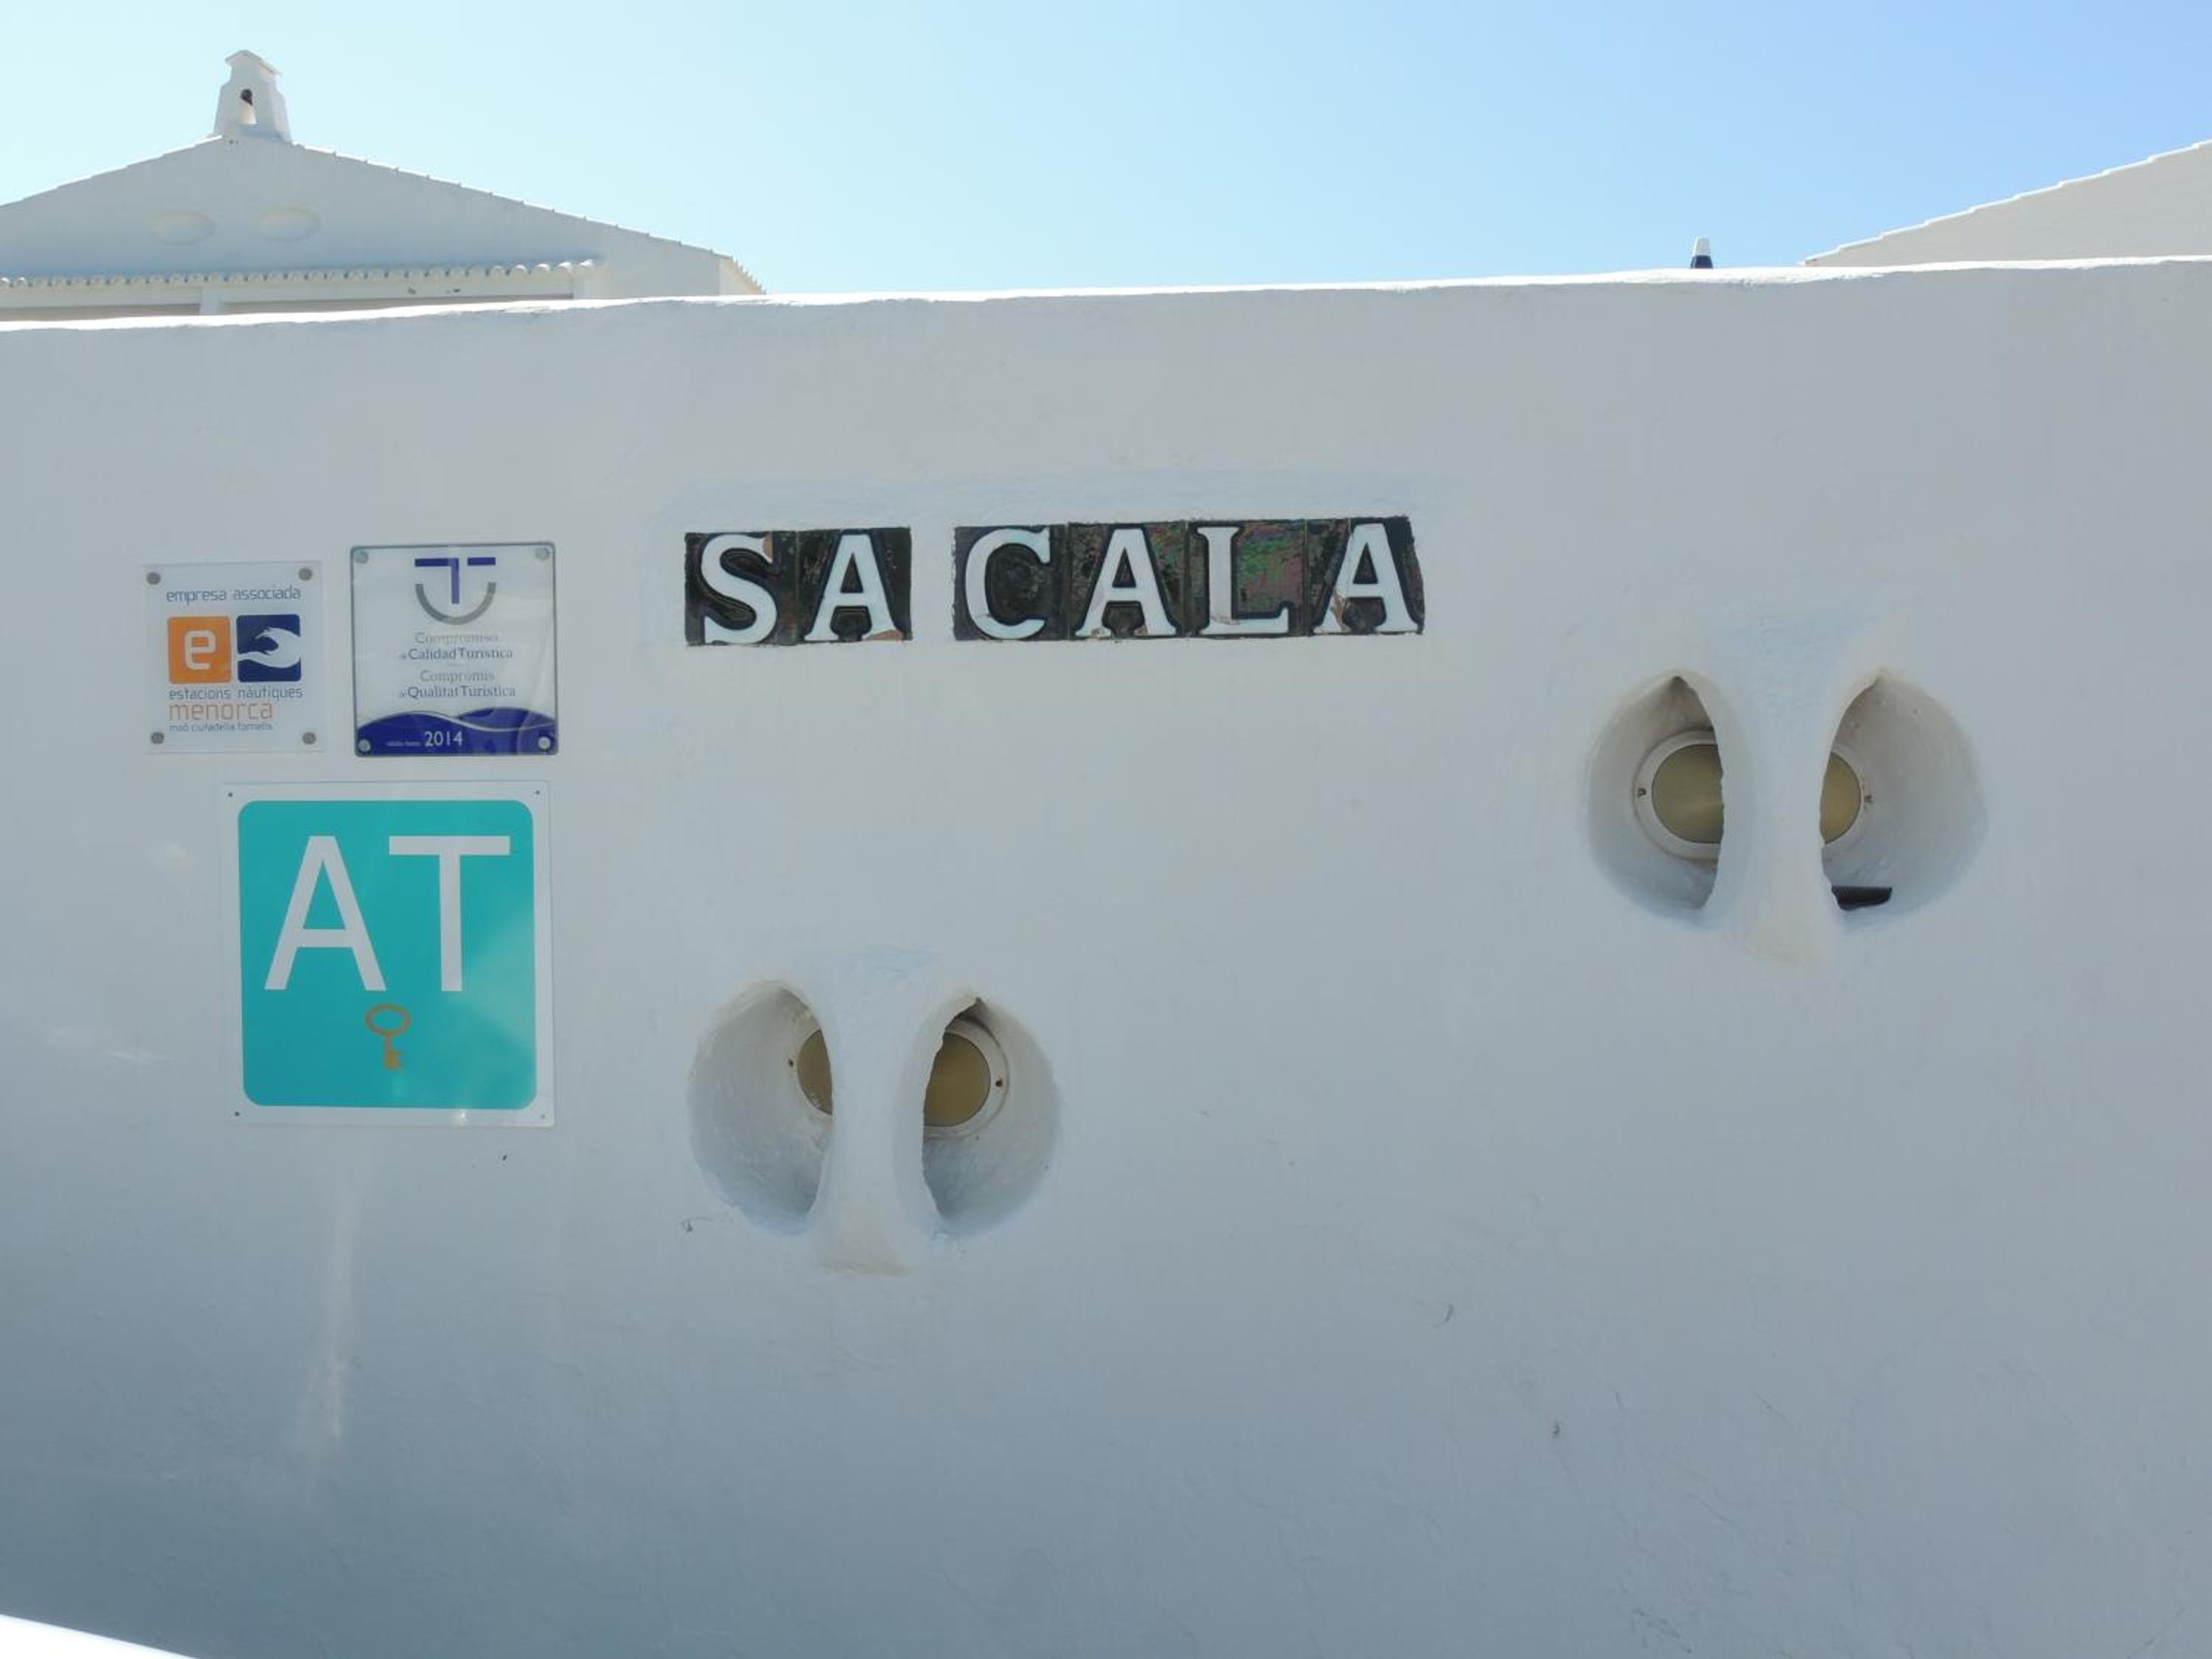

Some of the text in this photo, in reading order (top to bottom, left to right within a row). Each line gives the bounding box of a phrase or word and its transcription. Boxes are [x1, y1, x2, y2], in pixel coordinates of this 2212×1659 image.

[700, 522, 1419, 644] SA CALA
[166, 585, 301, 605] empresa associada
[408, 648, 456, 661] Calidad
[169, 686, 232, 700] estacions
[407, 684, 459, 700] Qualitat
[169, 702, 273, 721] menorca
[424, 731, 463, 747] 2014
[264, 835, 511, 992] AT
